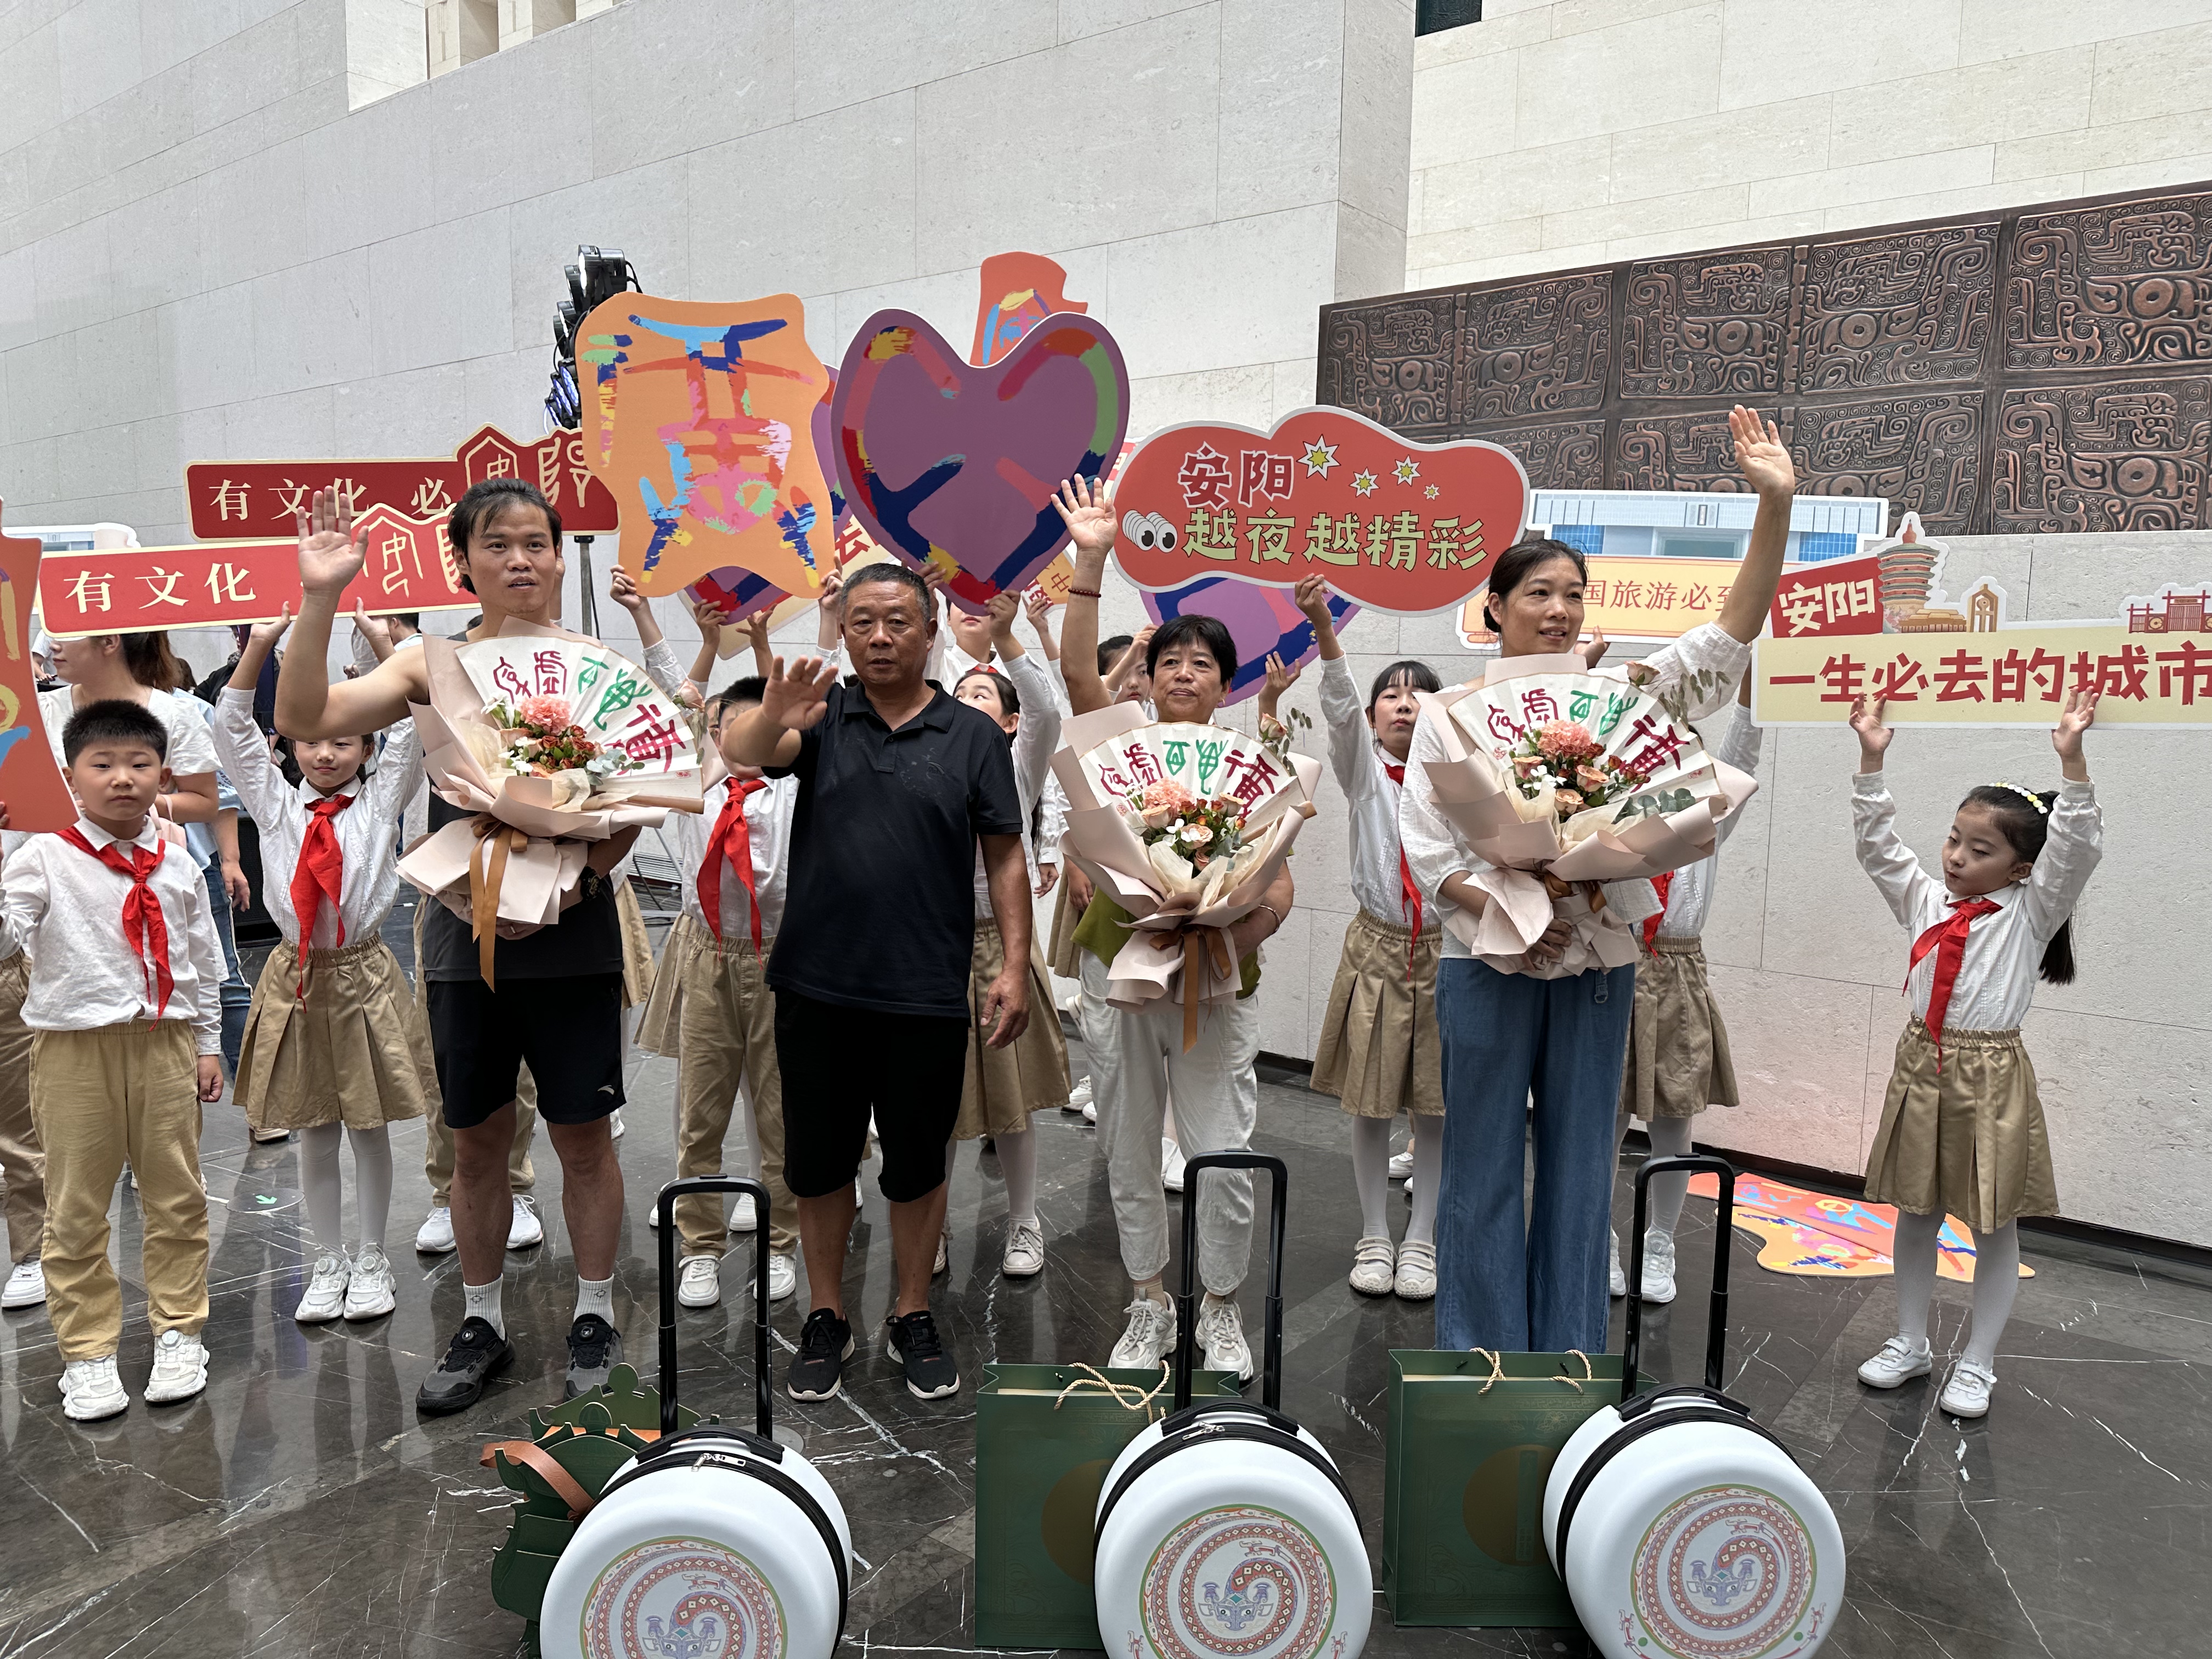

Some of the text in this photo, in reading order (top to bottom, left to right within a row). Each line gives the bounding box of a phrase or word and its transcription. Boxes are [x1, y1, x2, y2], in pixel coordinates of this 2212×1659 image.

[1177, 441, 1294, 511] 安阳
[1183, 507, 1488, 572] 越夜越精彩
[64, 563, 256, 614] 有文化
[1779, 578, 1875, 637] 安阳
[1770, 640, 2212, 706] 一生必去的城市
